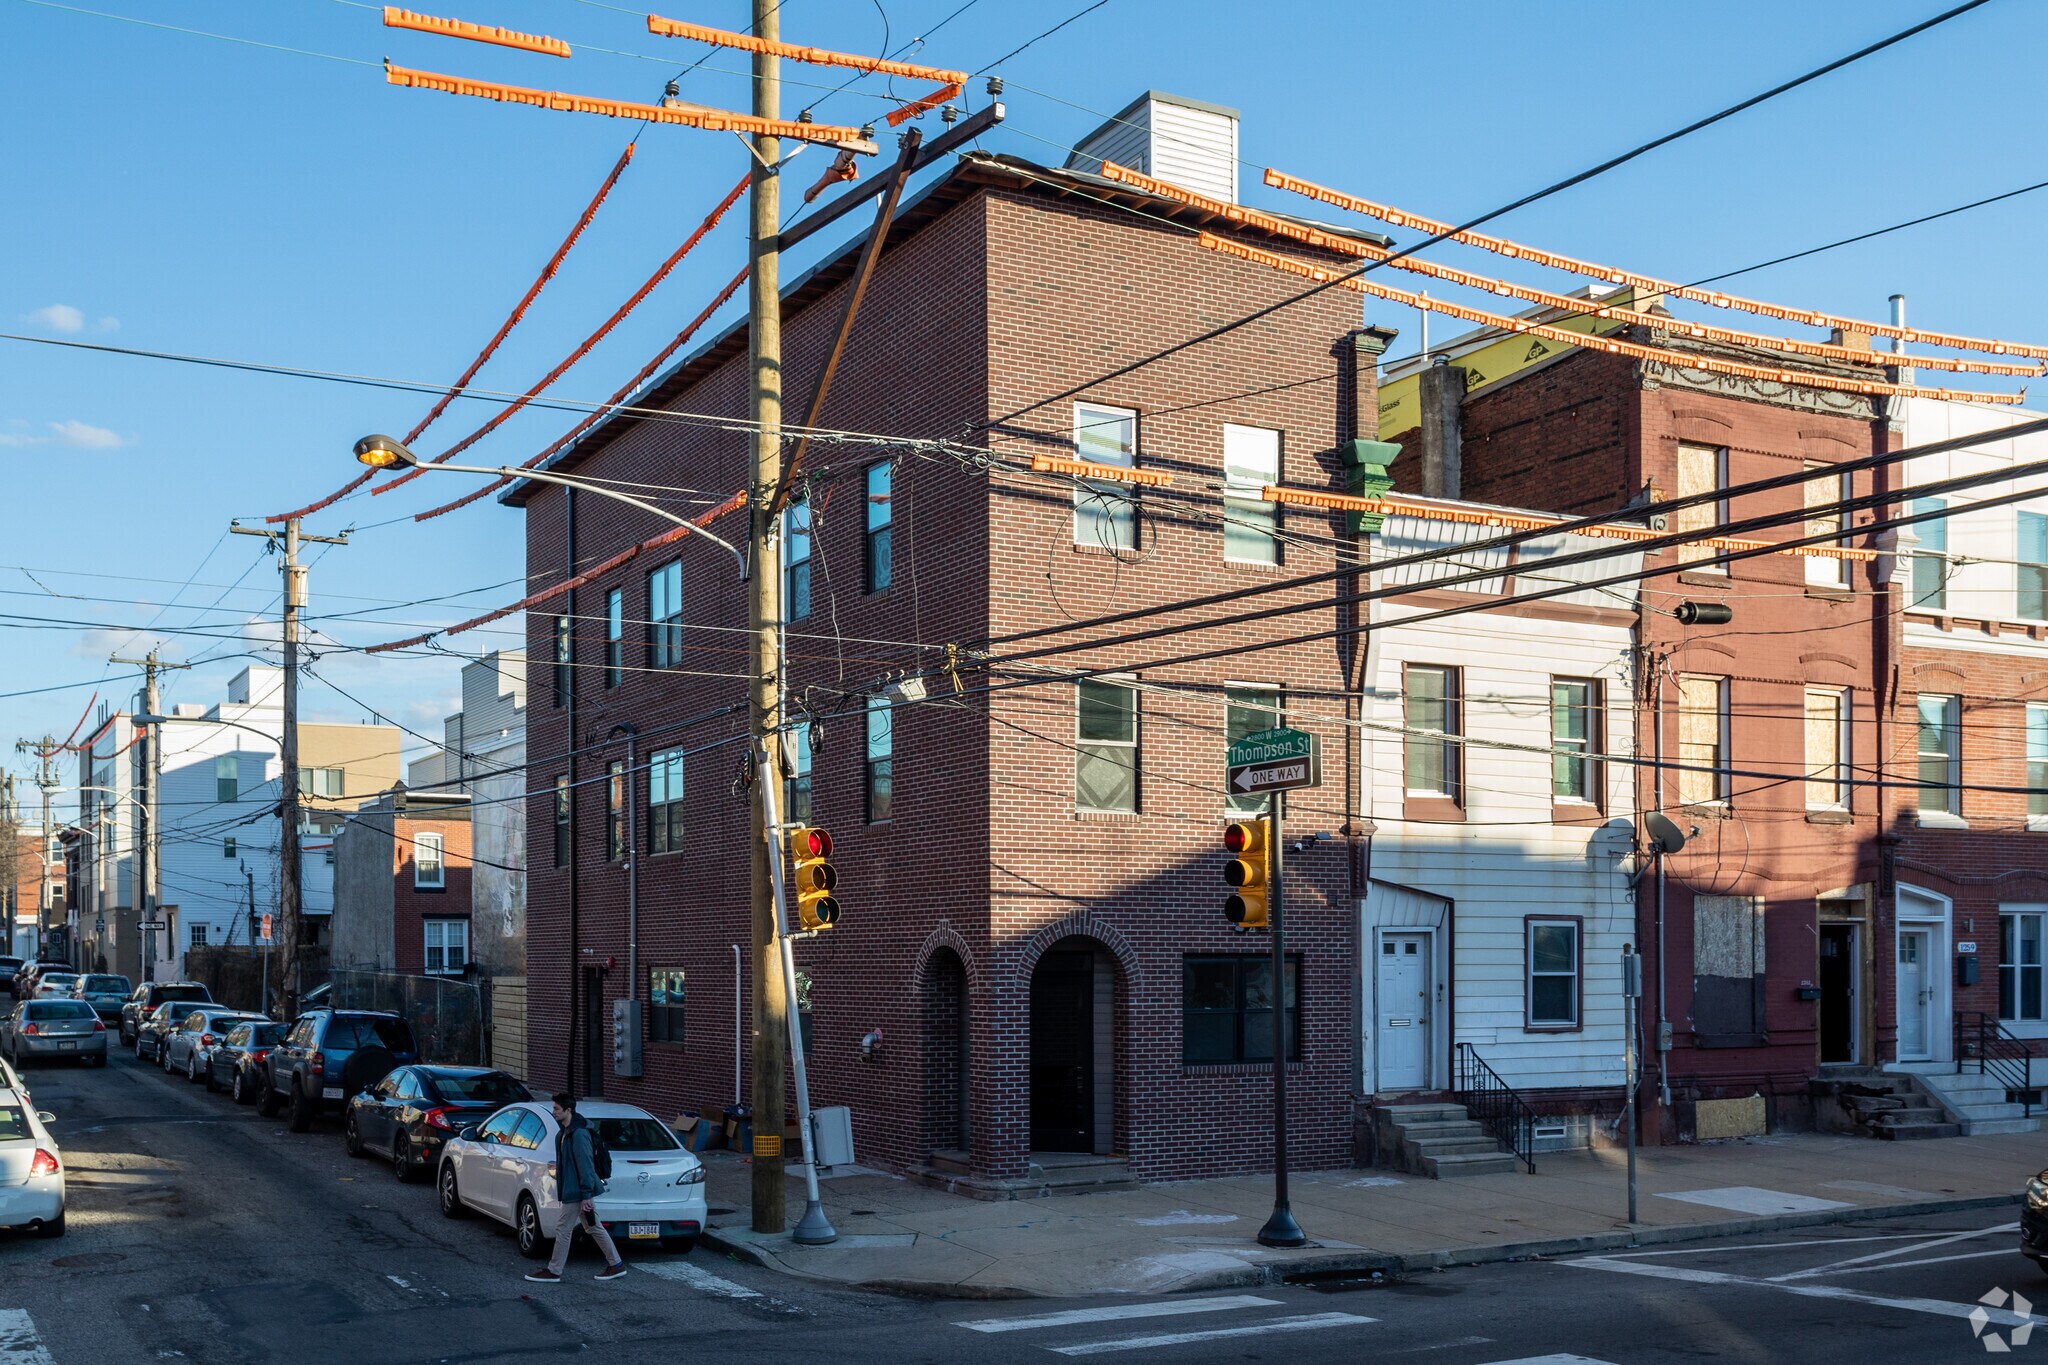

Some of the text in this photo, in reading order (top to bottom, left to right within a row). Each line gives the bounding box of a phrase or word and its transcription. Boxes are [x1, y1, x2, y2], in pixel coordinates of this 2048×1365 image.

[1265, 731, 1272, 740] W
[1231, 737, 1309, 763] Thompson St
[1252, 766, 1301, 784] ONE WAY
